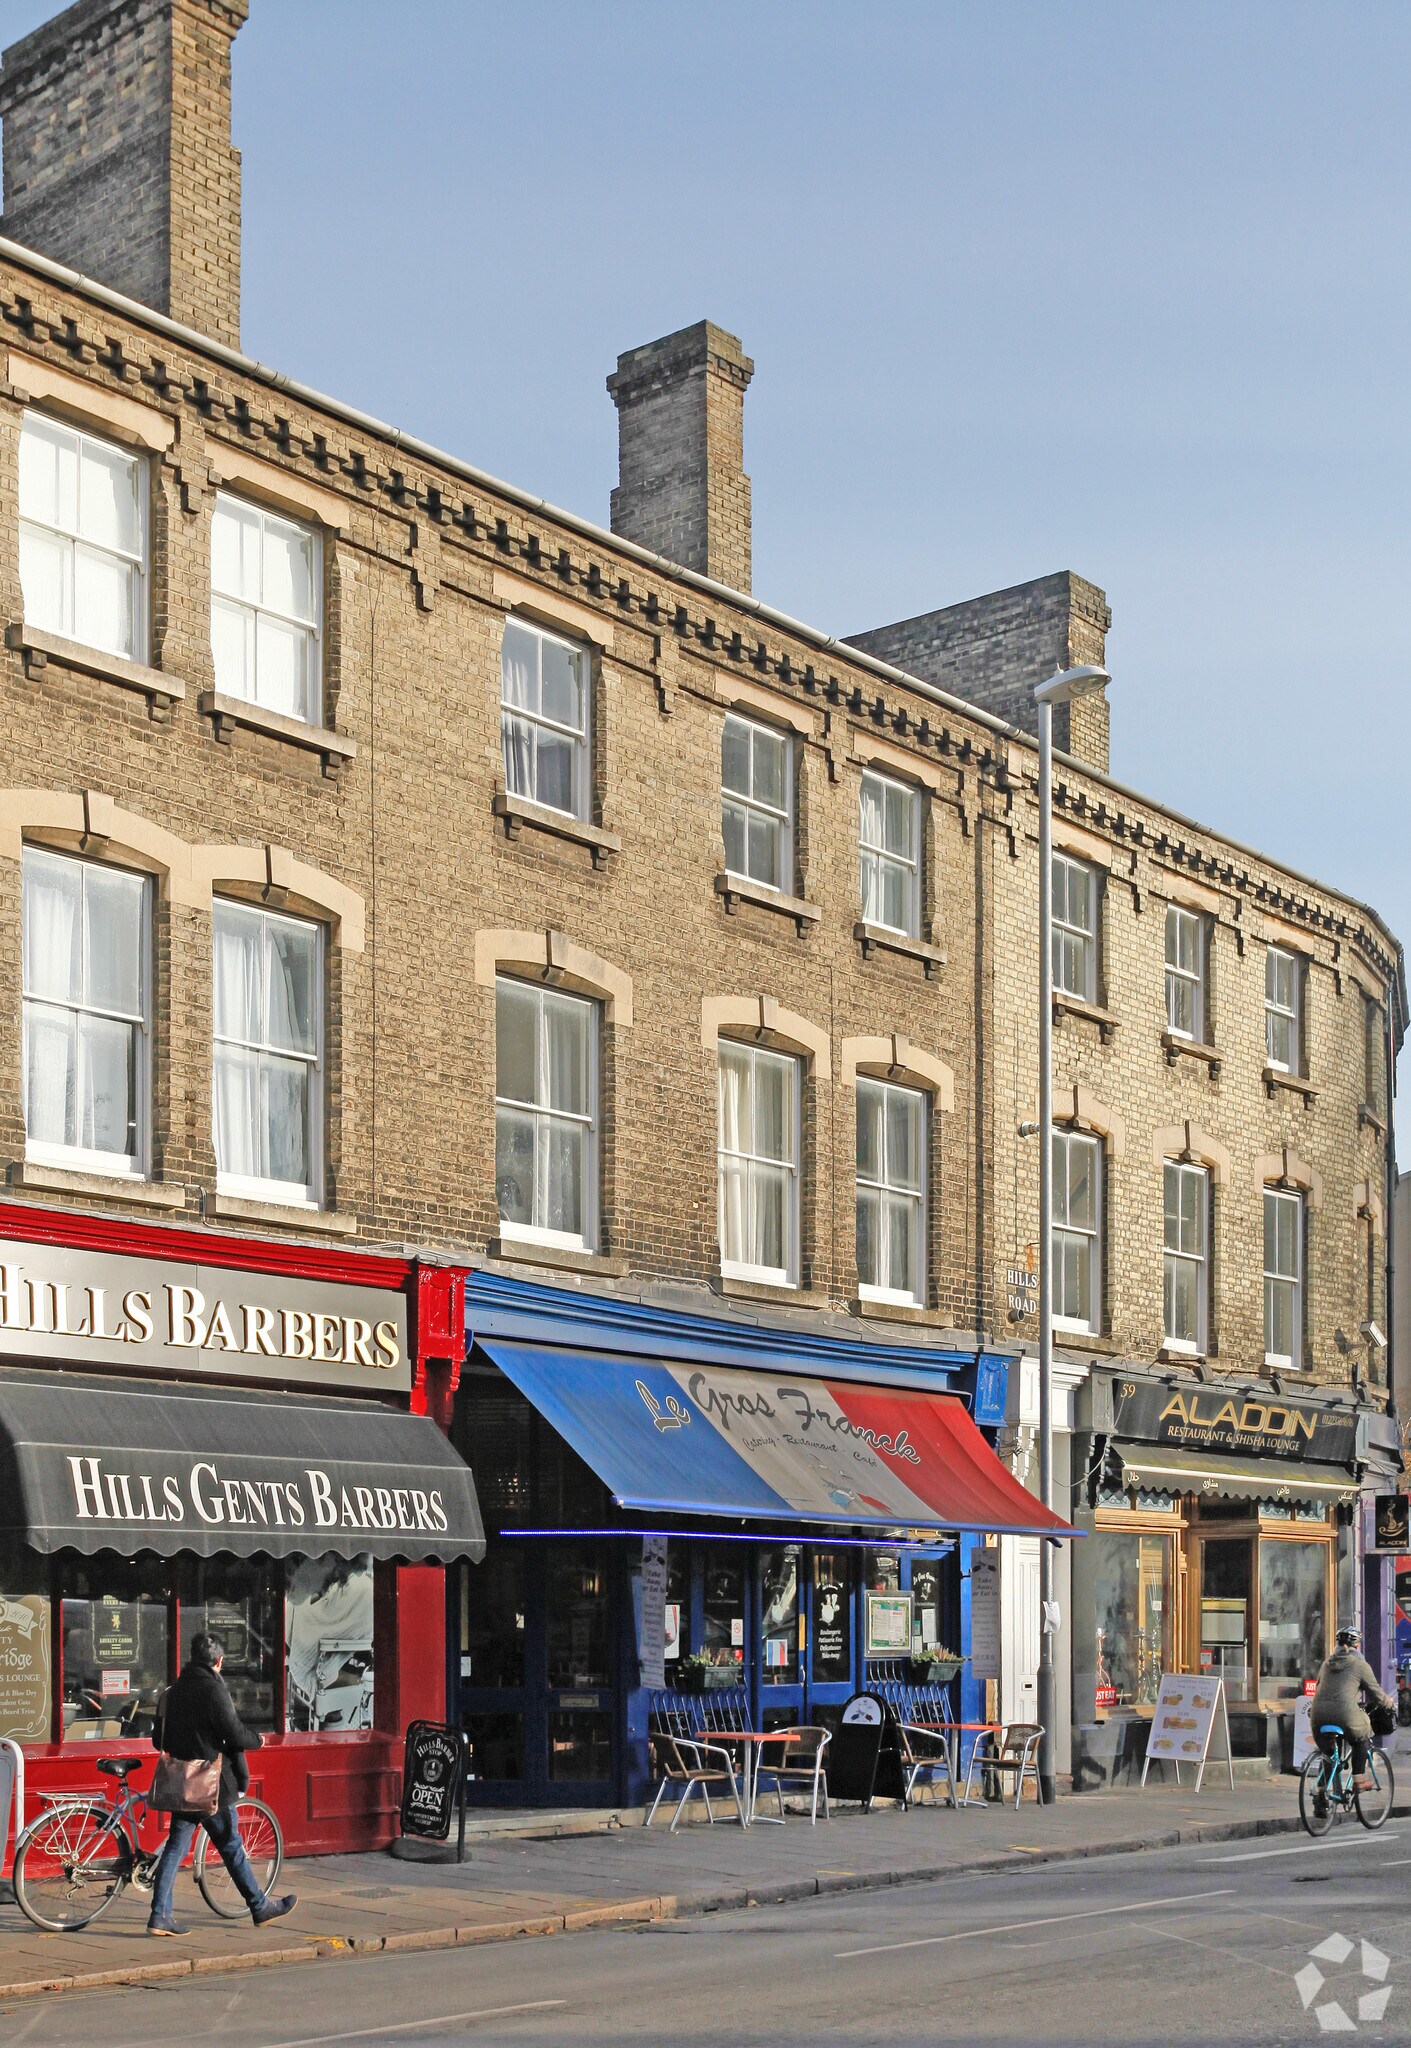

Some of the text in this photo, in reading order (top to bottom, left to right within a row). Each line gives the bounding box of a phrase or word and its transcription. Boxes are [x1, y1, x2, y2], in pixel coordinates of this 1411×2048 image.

[1007, 1269, 1037, 1288] HILLS
[1008, 1294, 1037, 1314] ROAD
[162, 1283, 401, 1370] BARBERS
[1120, 1383, 1136, 1399] 59
[634, 1372, 921, 1465] Le Gros Franck
[742, 1437, 777, 1452] Catering
[1167, 1425, 1300, 1451] RESTAURANT & SHISHA LOUNGE
[66, 1455, 449, 1533] HILLS GENTS BARBERS
[6, 1674, 41, 1682] LOUNGE
[1305, 1682, 1316, 1691] JUST
[12, 1689, 25, 1697] Blow
[26, 1689, 37, 1698] Dry
[1105, 1690, 1115, 1699] EAT
[416, 1737, 455, 1764] HILLS BARBER
[412, 1788, 444, 1806] OPEN
